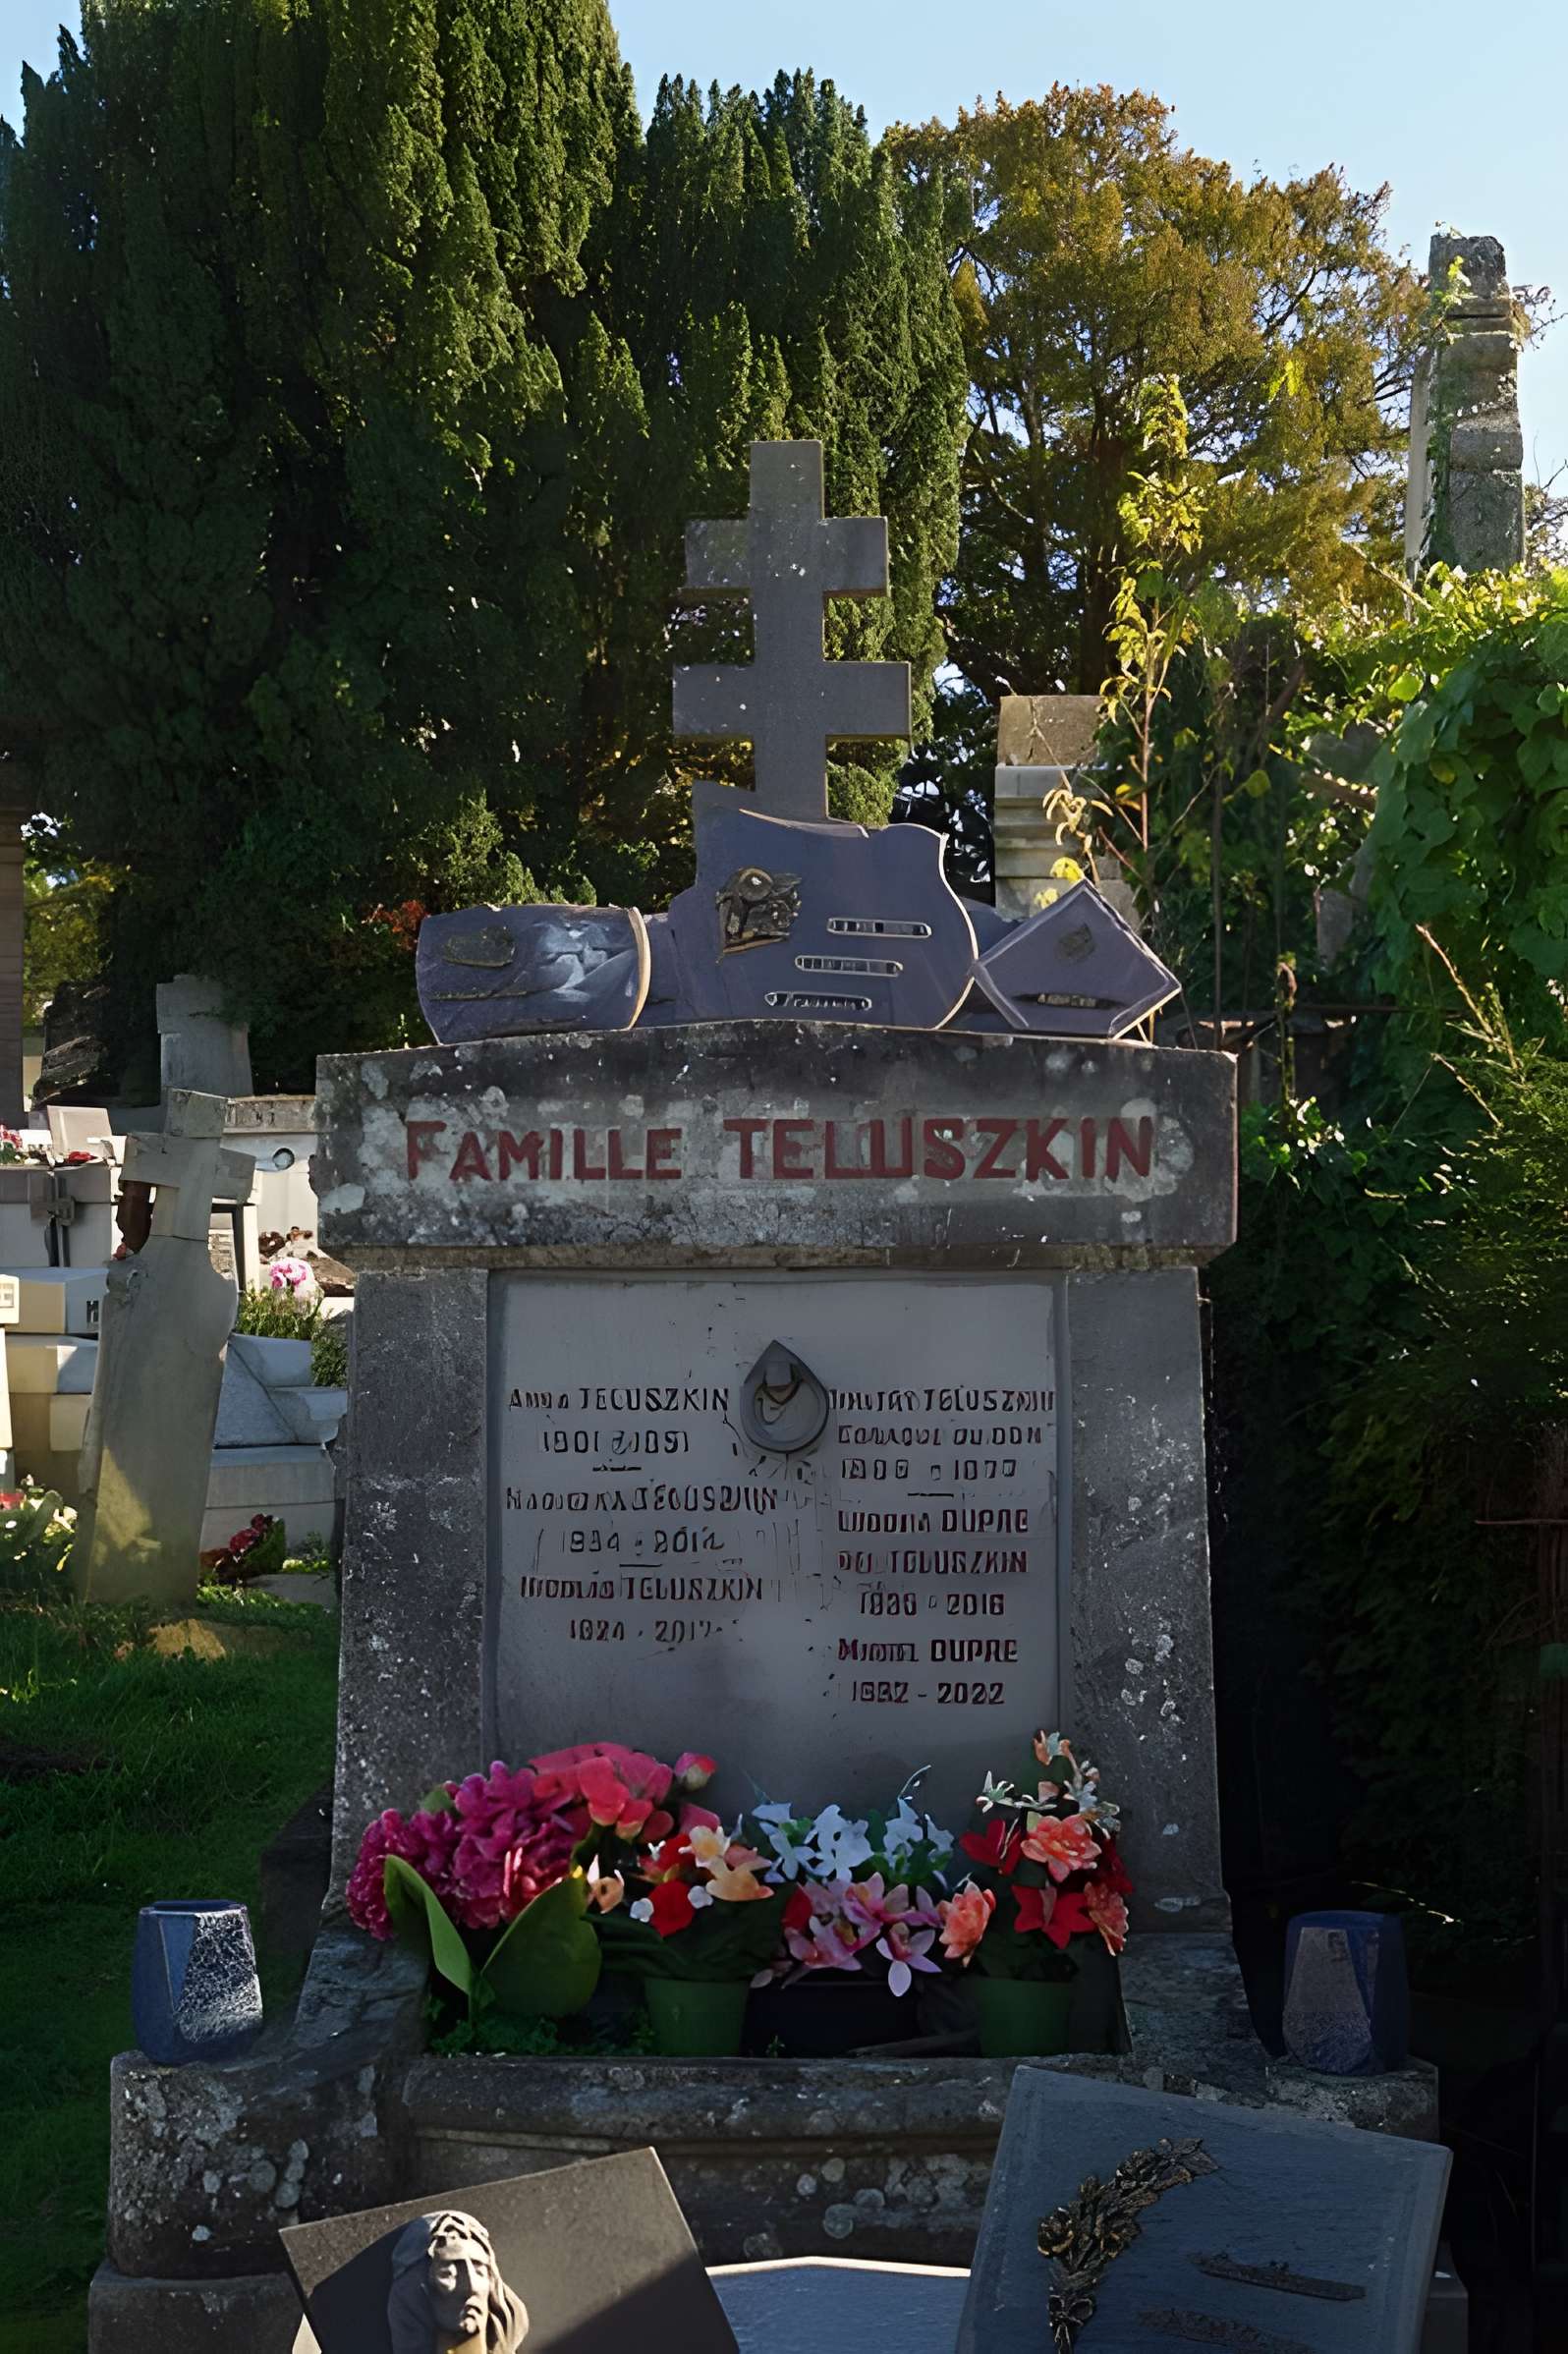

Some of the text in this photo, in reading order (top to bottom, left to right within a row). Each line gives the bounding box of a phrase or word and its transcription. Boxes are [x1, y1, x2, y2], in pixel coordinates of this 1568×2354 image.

[407, 1116, 1153, 1182] FAMILLE TELUSZKIN
[937, 1682, 1005, 1705] 2022
